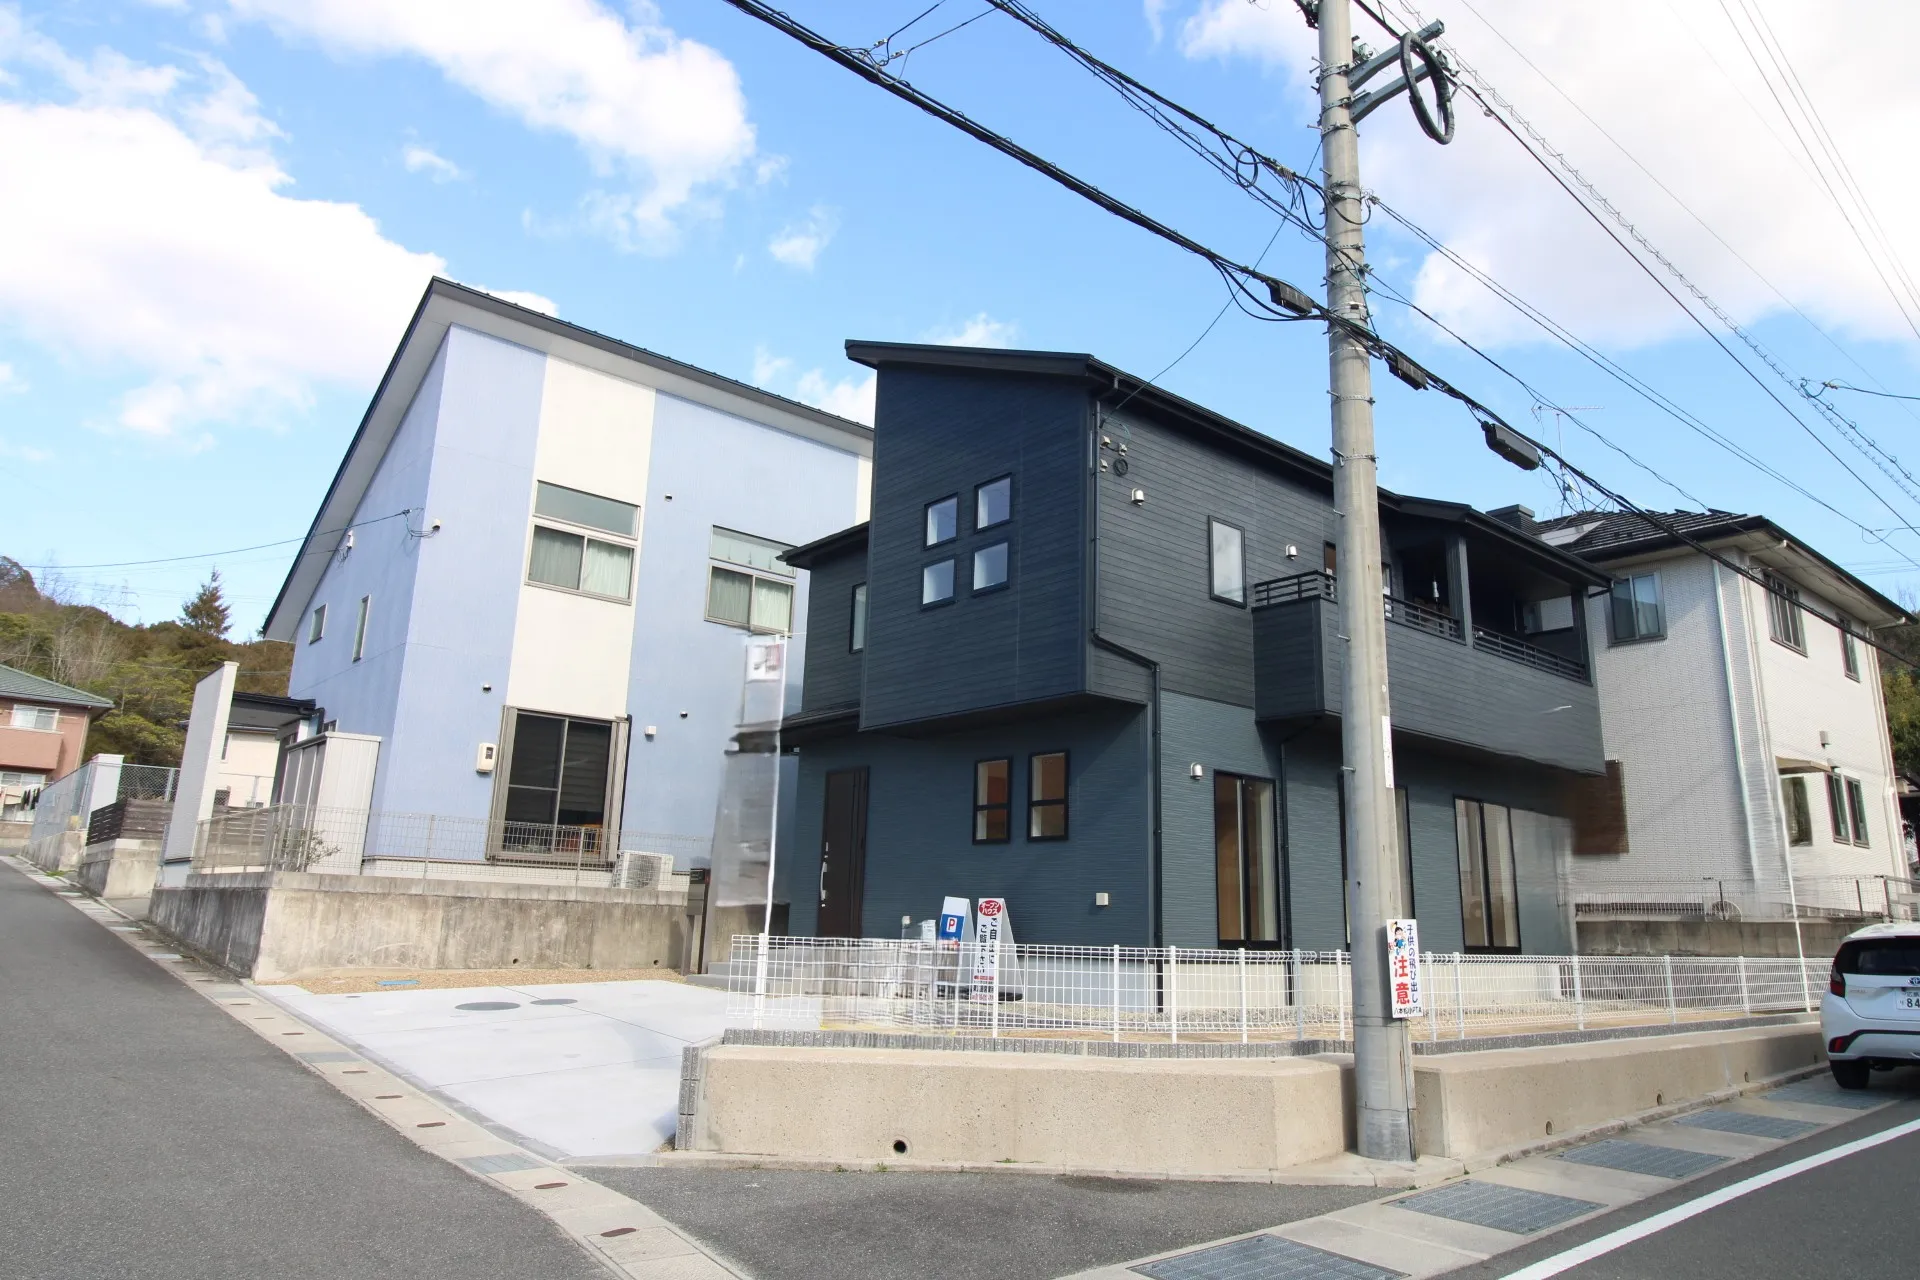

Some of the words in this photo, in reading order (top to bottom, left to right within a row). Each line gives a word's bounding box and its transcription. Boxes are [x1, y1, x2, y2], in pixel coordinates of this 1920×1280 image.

[948, 918, 955, 930] P
[1393, 955, 1410, 1005] 注意
[1406, 924, 1418, 1003] 子供の飛び出し
